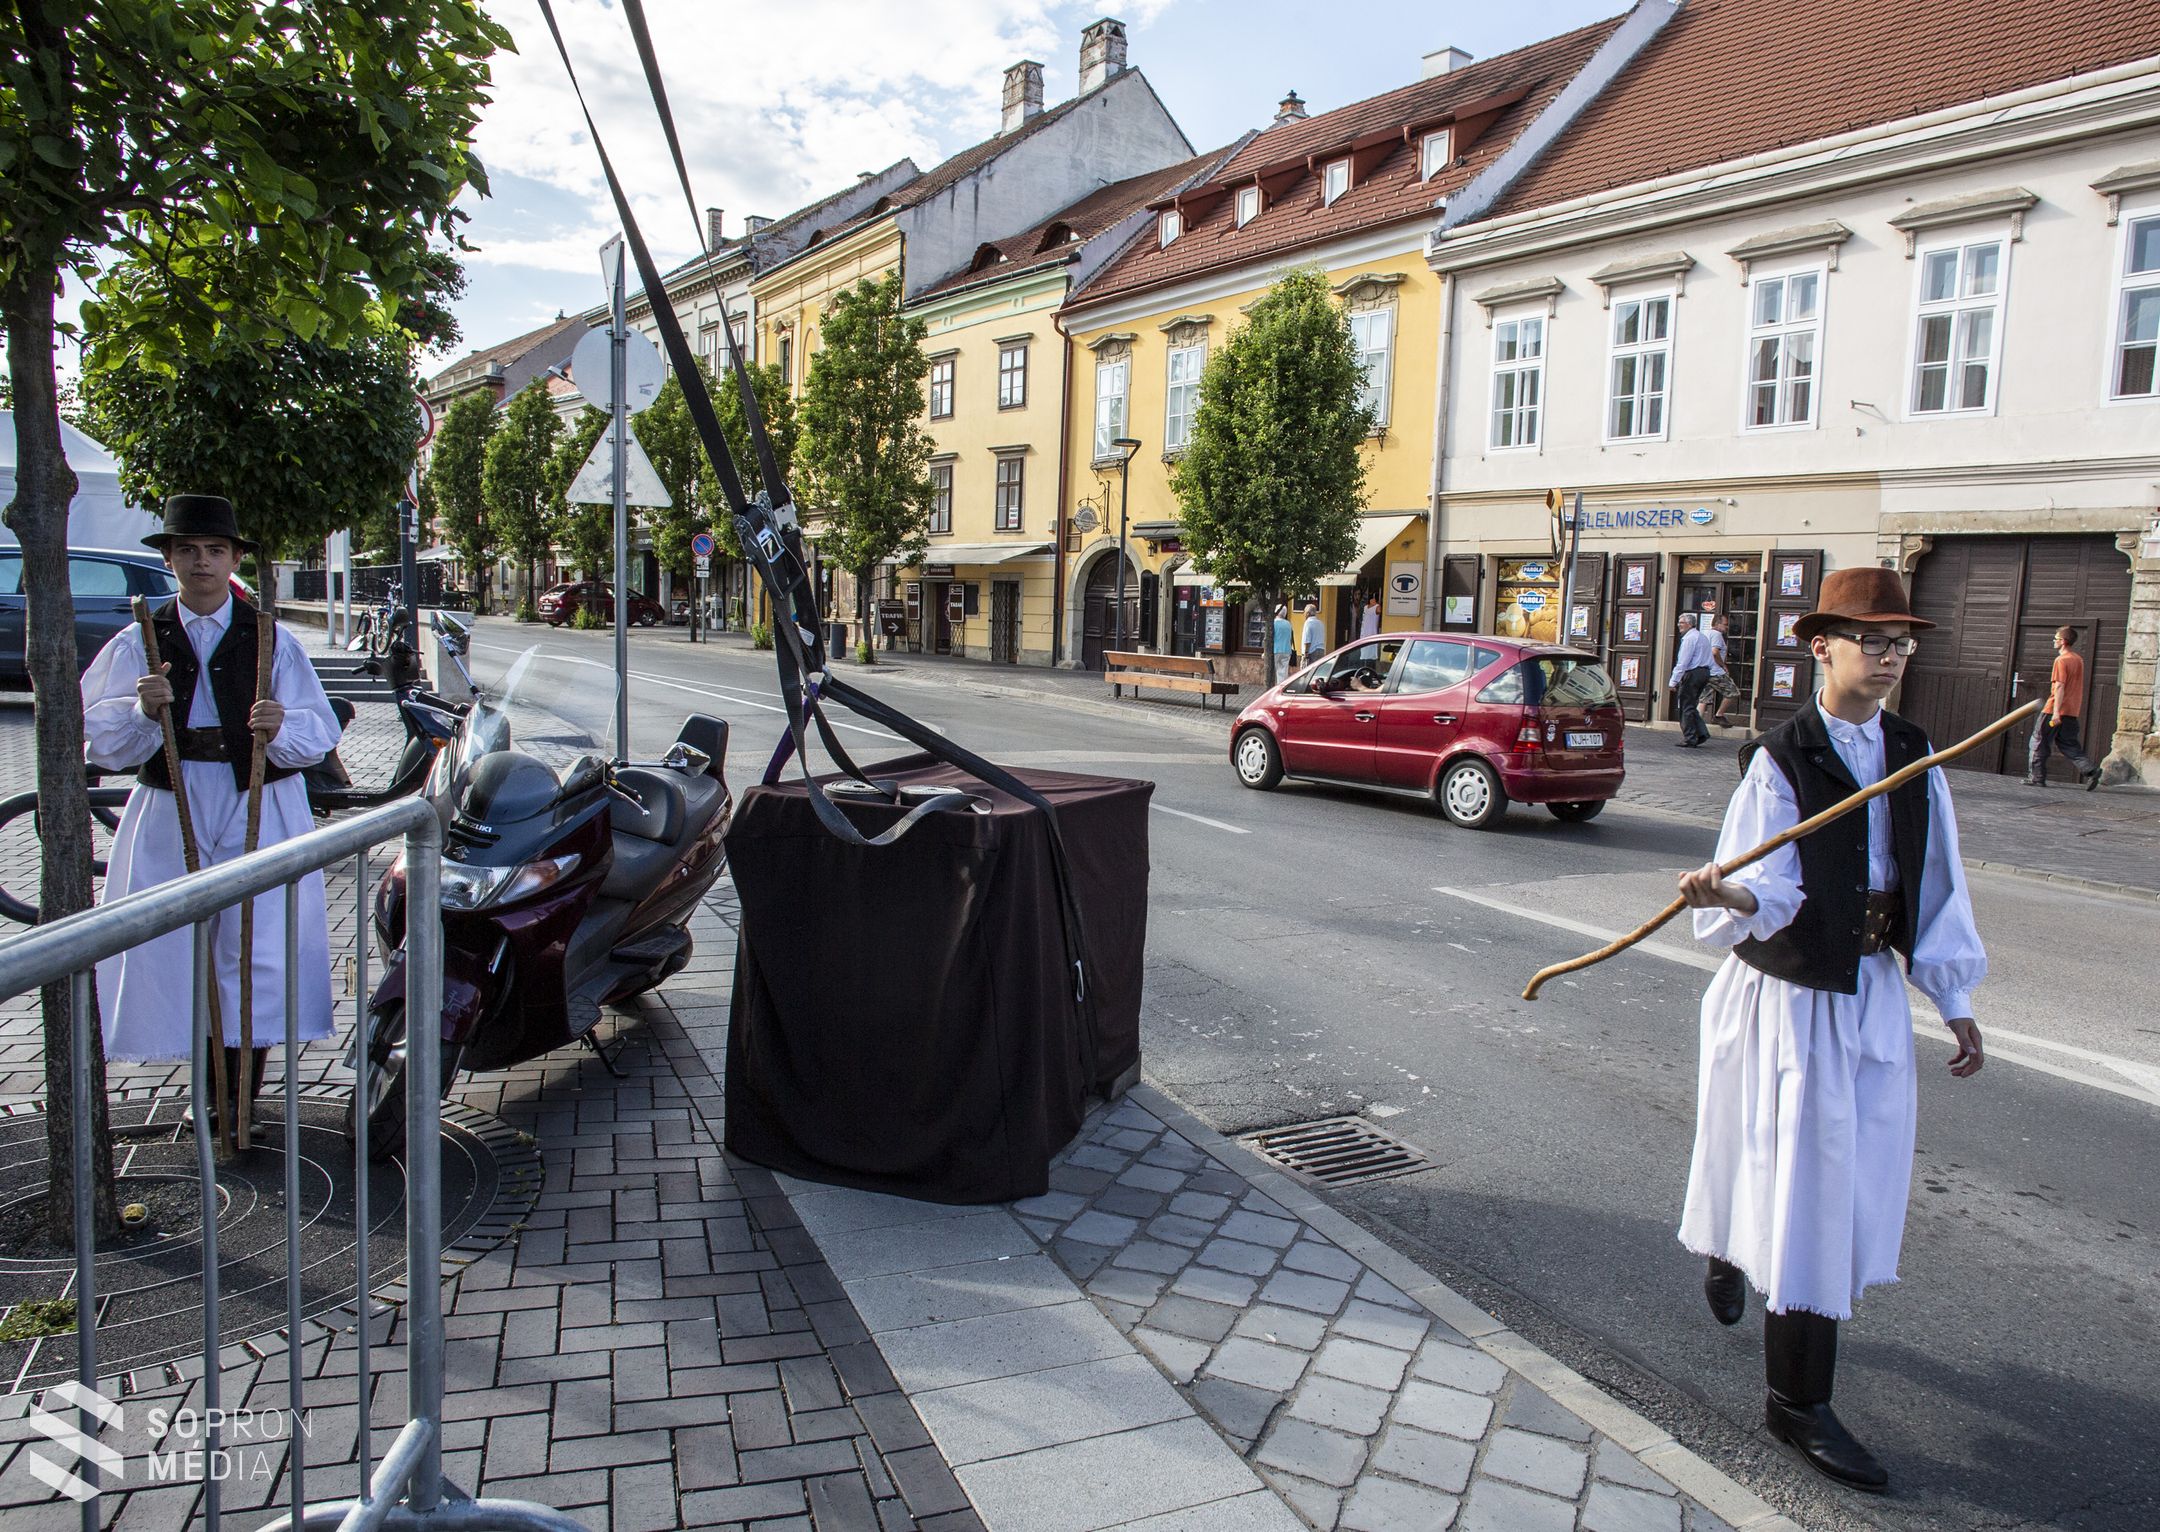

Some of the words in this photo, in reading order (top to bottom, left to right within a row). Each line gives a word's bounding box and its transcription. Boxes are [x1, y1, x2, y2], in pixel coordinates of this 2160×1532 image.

[1519, 596, 1544, 604] PAROLA
[1571, 735, 1601, 744] NJH-107
[460, 818, 492, 833] SUZUKI
